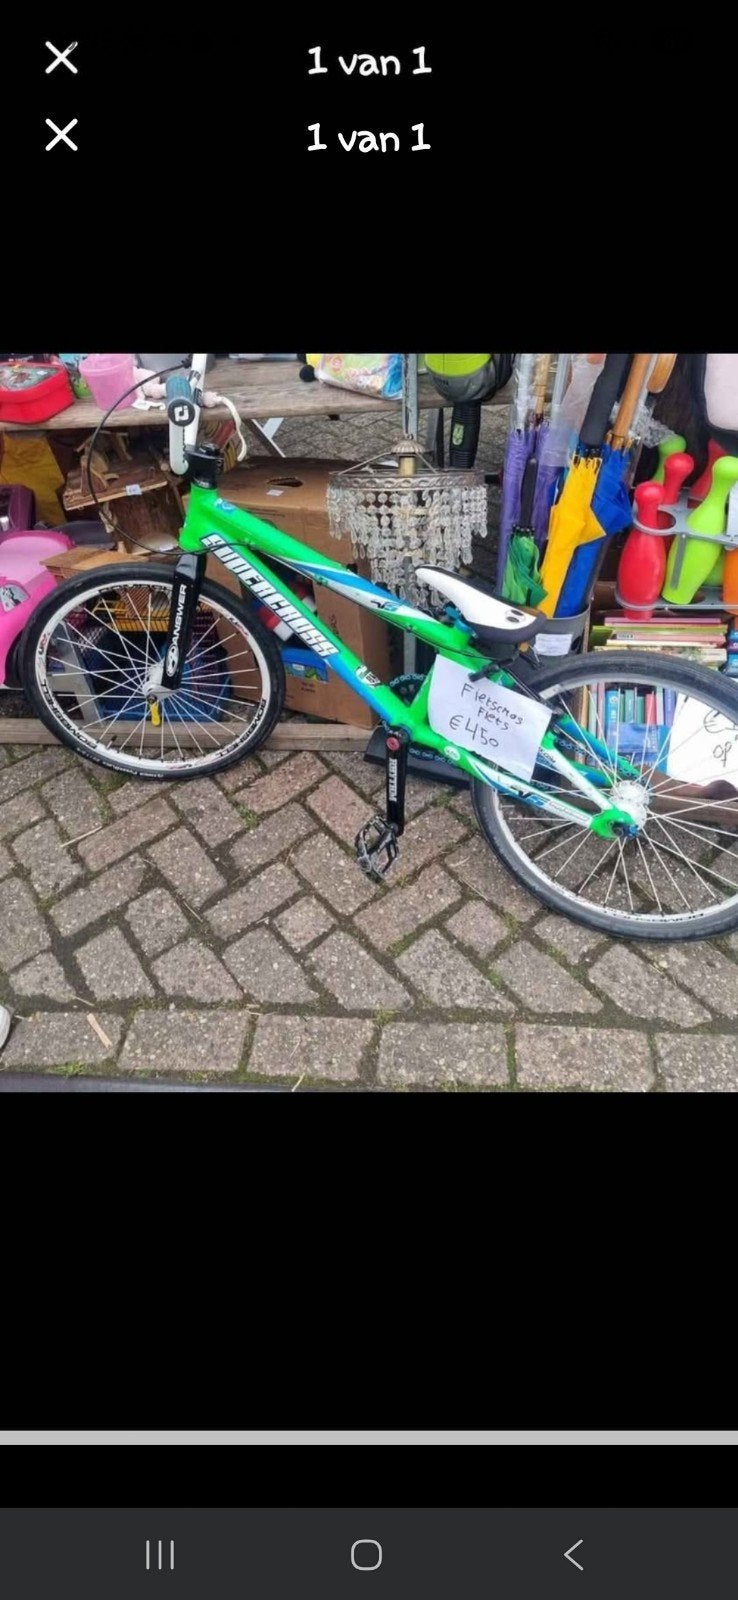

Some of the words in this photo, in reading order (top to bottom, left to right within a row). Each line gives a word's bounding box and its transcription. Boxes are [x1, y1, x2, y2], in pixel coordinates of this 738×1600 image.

[171, 584, 187, 647] ANSWER
[200, 532, 340, 657] SUPERCROSS
[448, 714, 500, 748] €450
